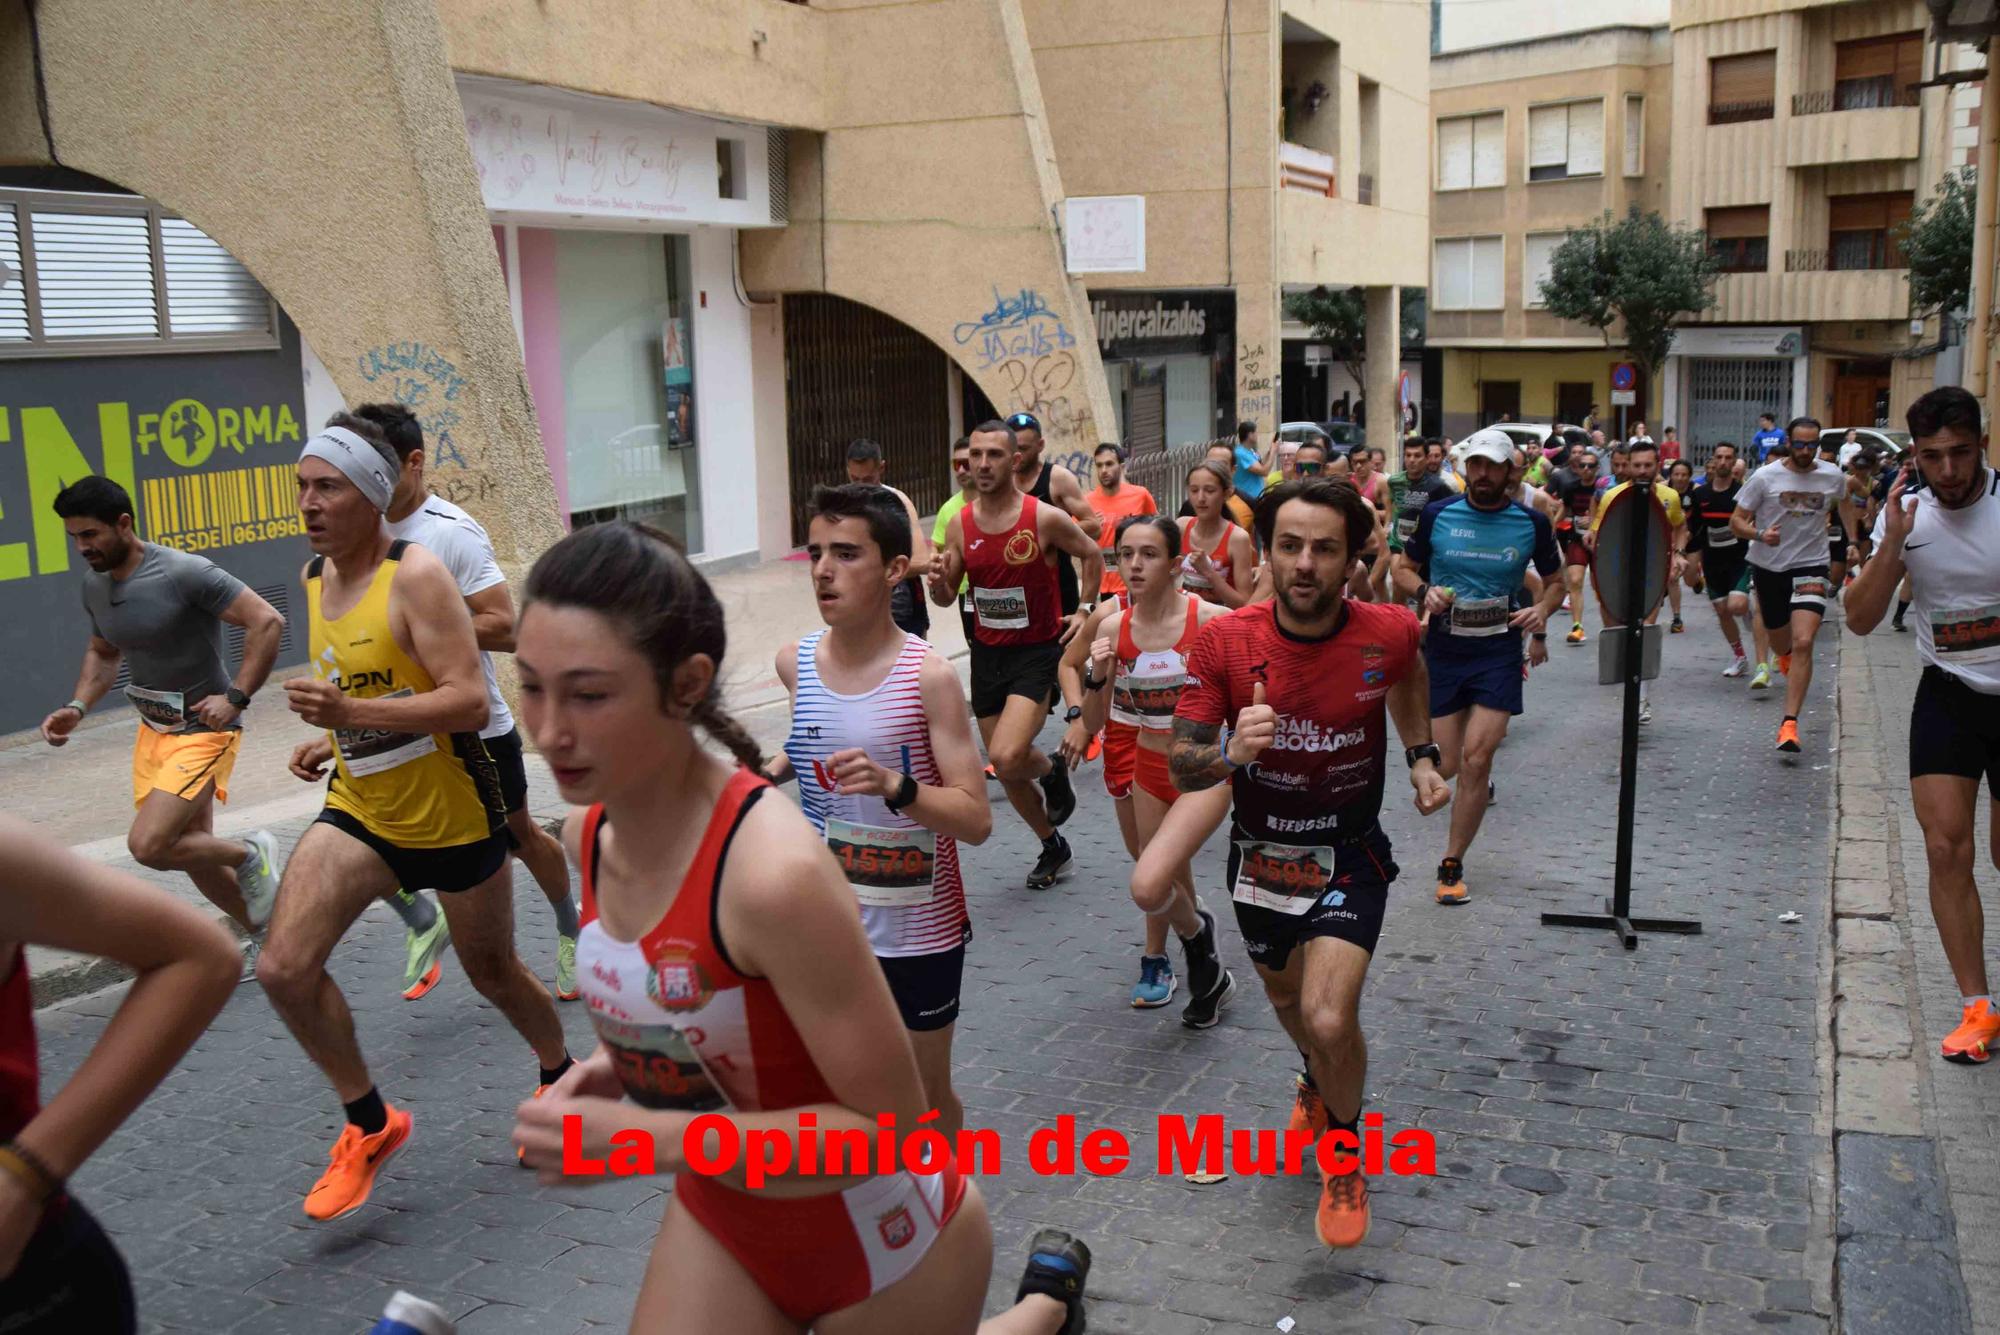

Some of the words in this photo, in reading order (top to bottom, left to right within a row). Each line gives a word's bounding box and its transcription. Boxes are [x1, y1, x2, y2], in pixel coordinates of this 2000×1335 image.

[159, 529, 221, 553] DESDE
[233, 518, 299, 546] 061096
[1274, 714, 1320, 736] RAIL
[840, 844, 924, 875] 1570
